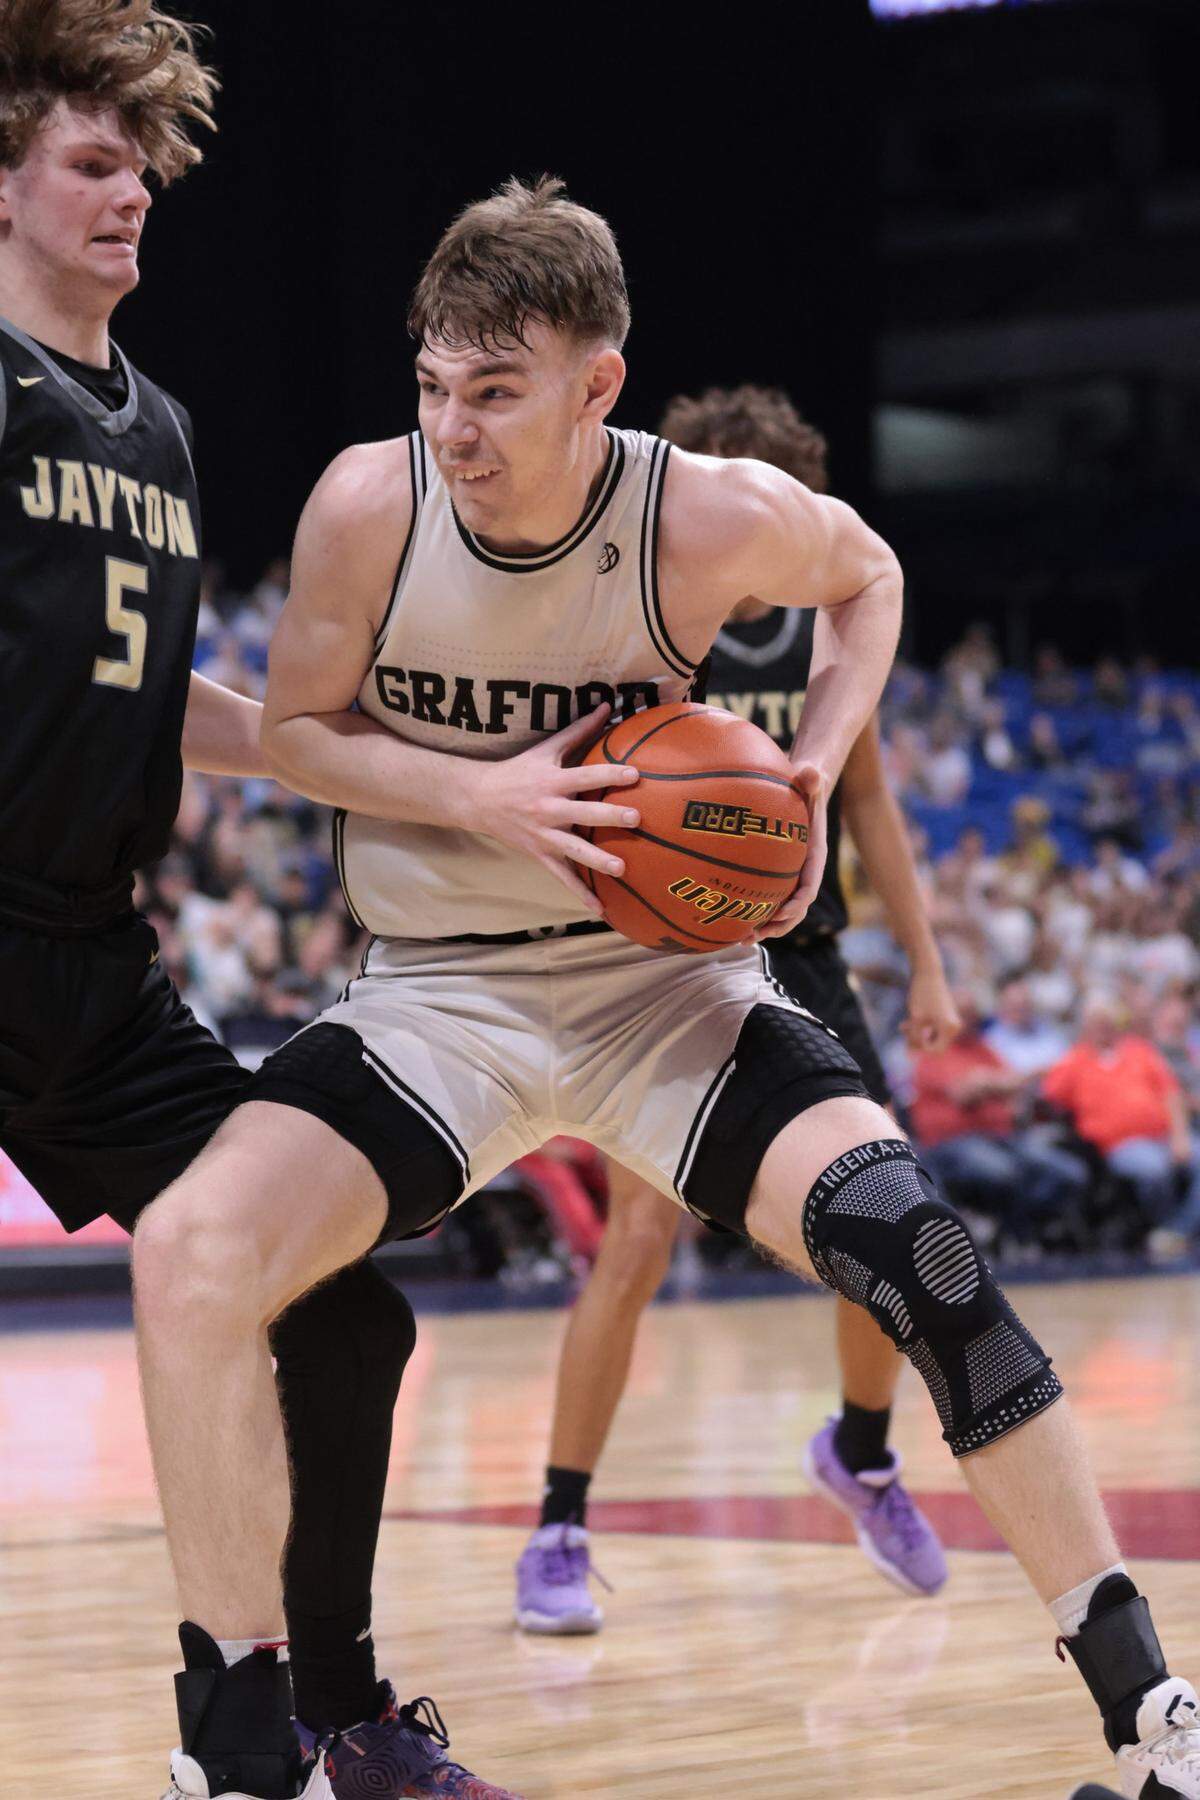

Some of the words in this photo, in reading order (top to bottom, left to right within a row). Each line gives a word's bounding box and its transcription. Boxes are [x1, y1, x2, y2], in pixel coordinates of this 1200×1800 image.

[20, 455, 198, 559] JAYTON
[92, 555, 148, 691] 5
[668, 876, 781, 928] aden
[820, 1141, 895, 1188] NEENCA
